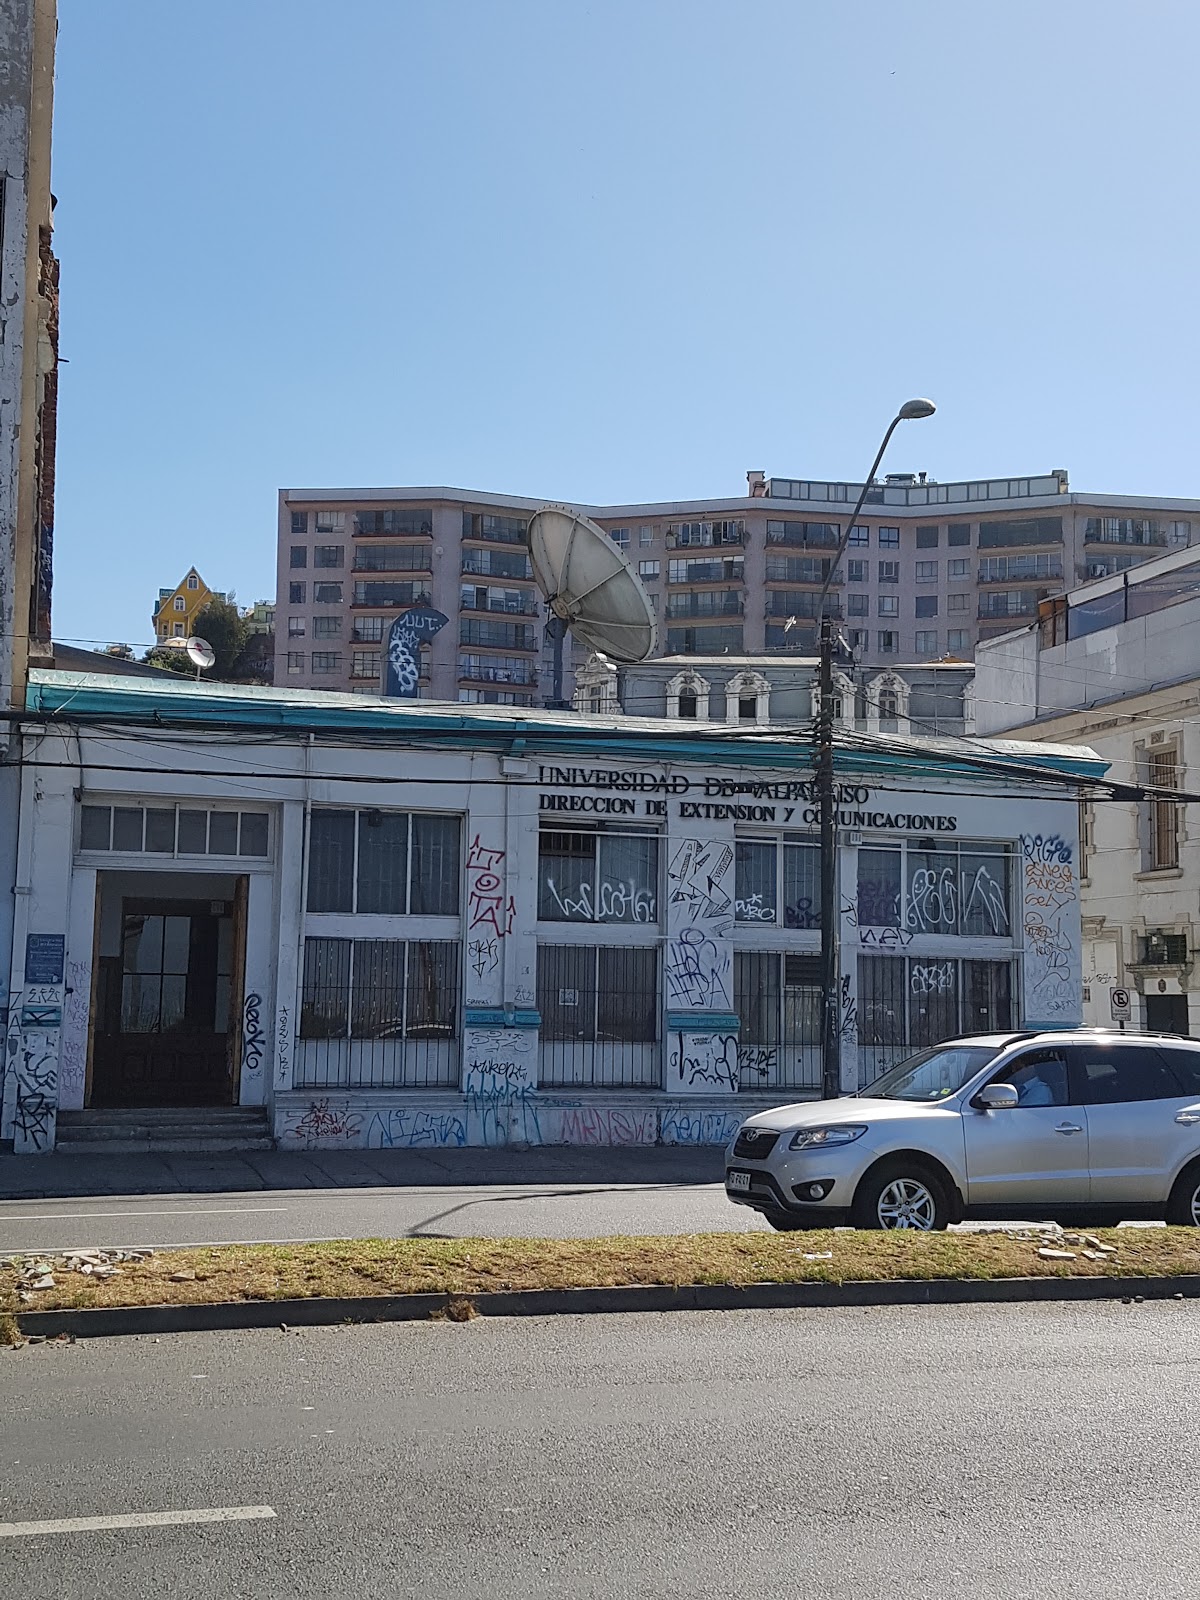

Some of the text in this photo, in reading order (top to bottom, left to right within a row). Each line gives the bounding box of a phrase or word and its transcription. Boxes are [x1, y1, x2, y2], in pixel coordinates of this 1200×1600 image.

[538, 765, 690, 794] UNIVERSIDAD
[538, 794, 636, 815] DIRECCION
[645, 799, 667, 816] DE
[679, 801, 776, 822] EXTENSION
[783, 807, 795, 822] Y
